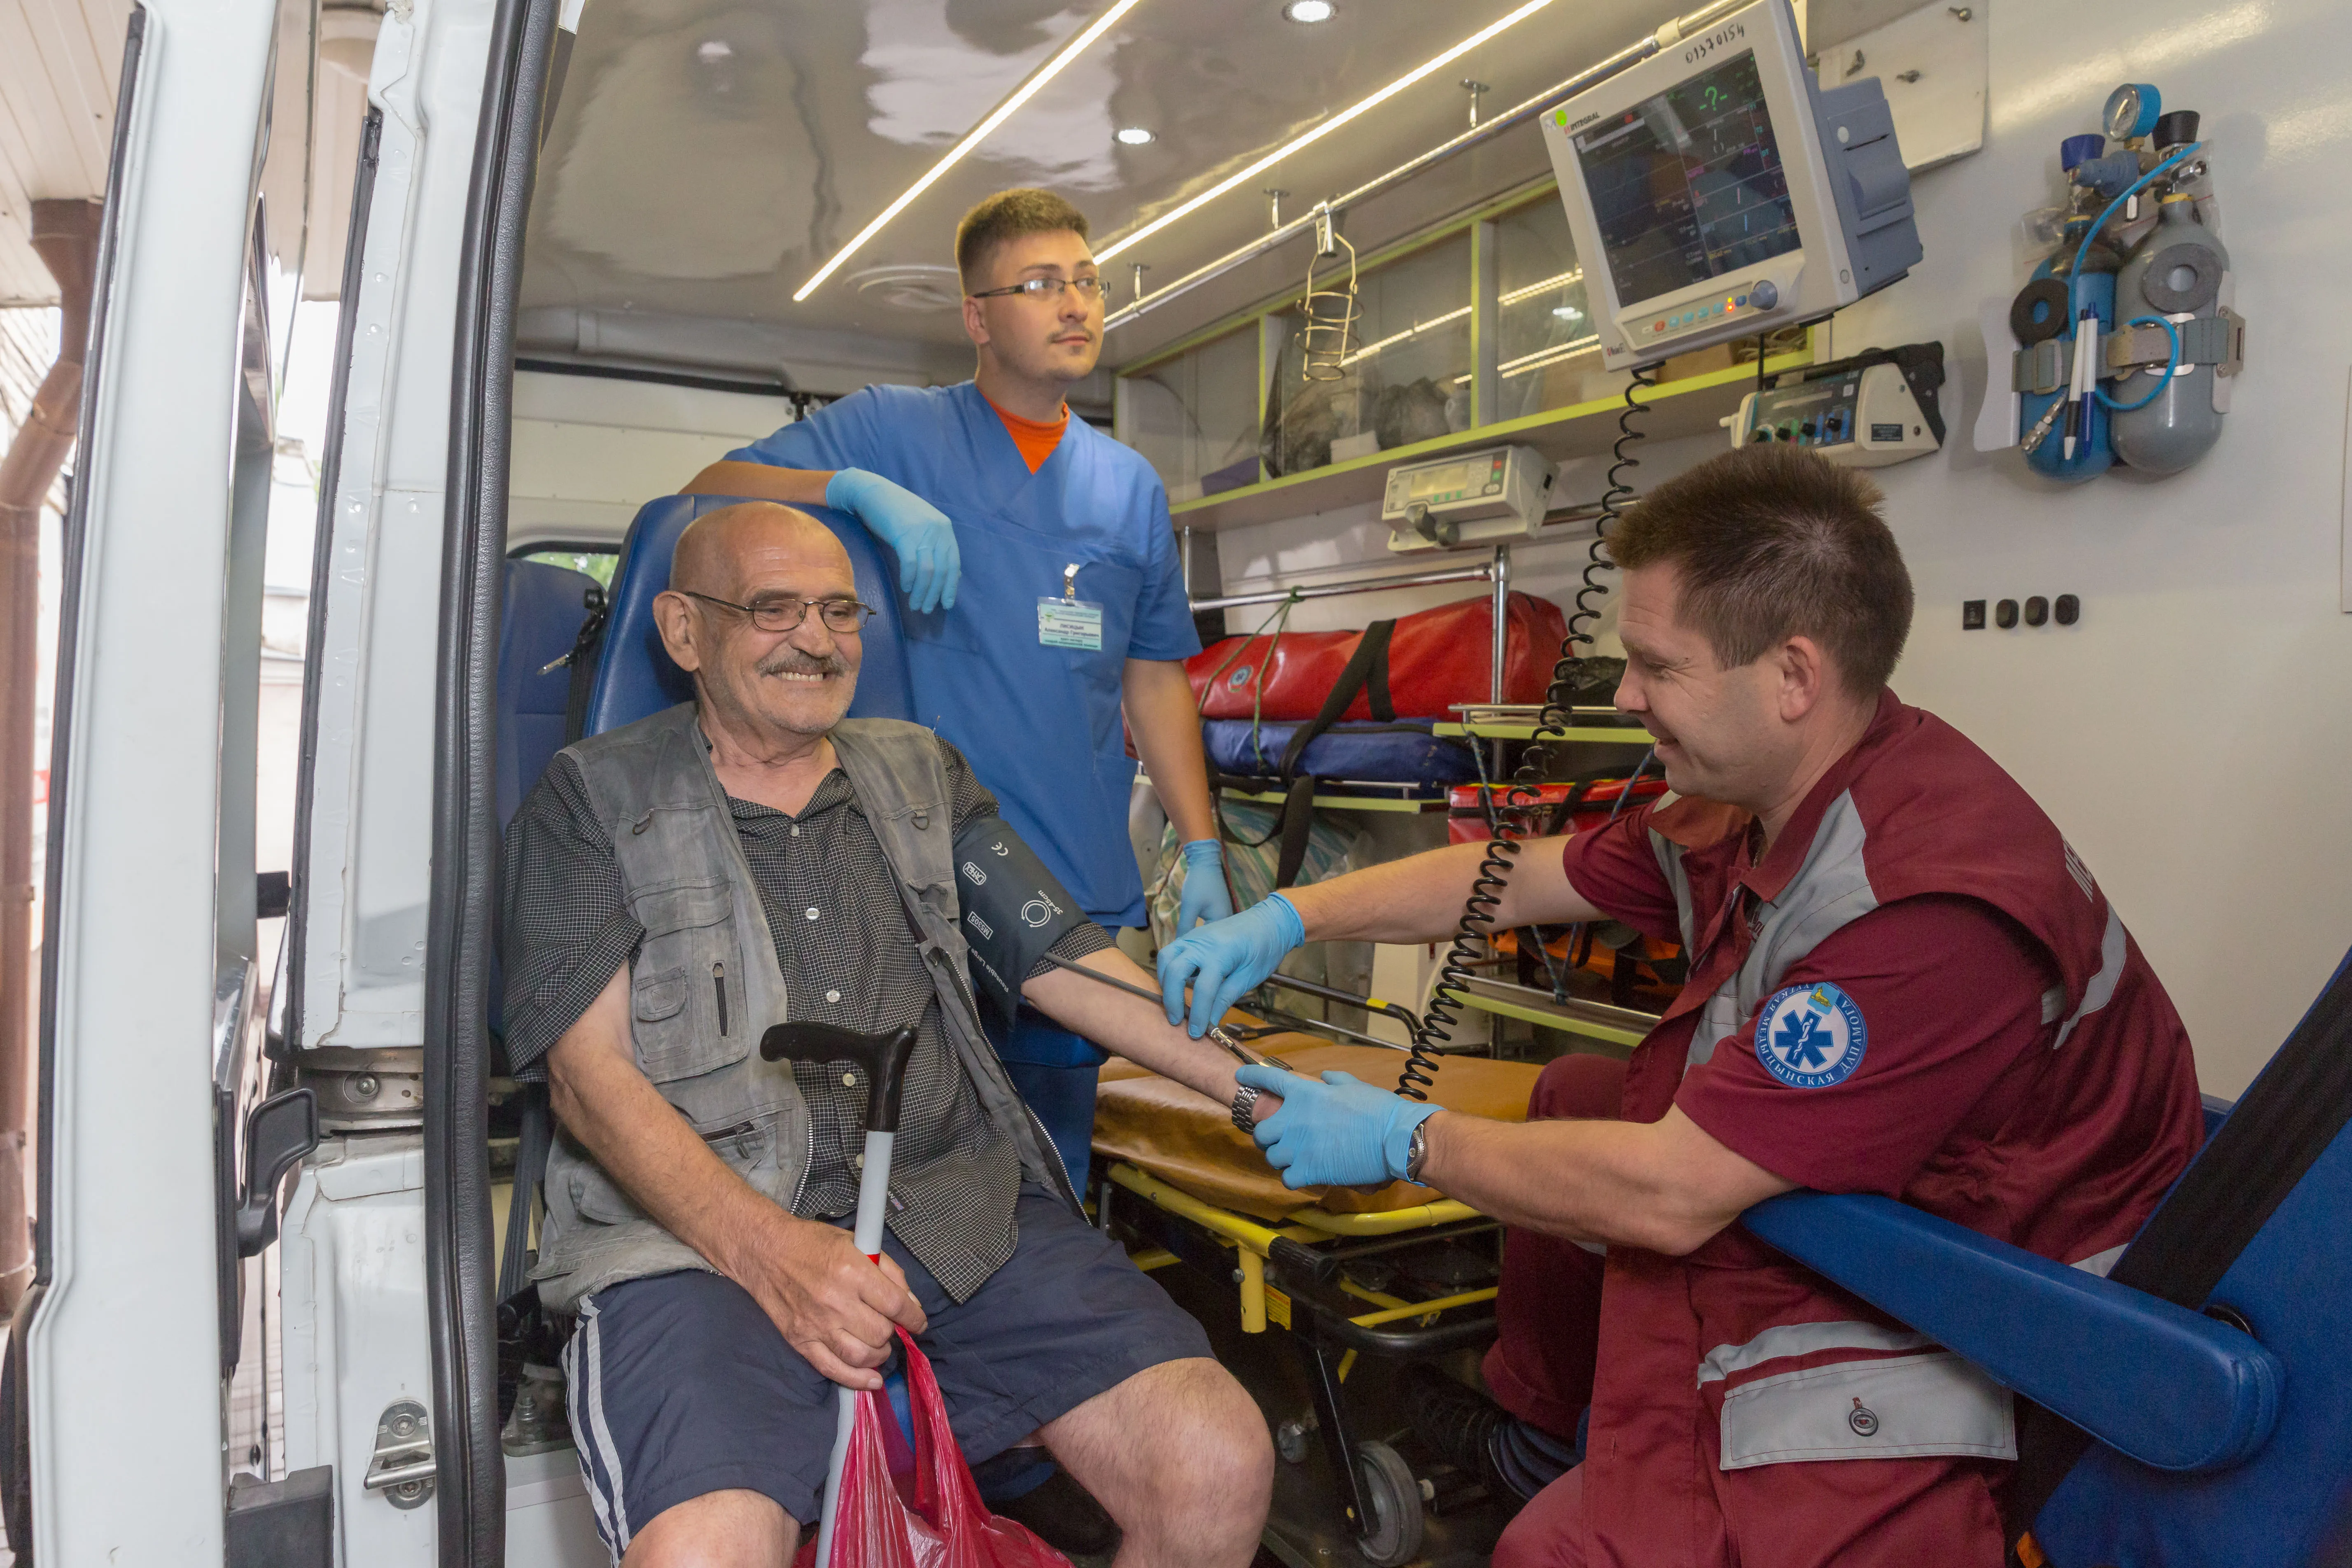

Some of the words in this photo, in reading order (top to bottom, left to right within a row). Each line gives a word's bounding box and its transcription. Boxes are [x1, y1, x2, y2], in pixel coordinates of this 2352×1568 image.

[1570, 111, 1600, 131] INTEGRAL
[1038, 890, 1063, 915] 35-45cm
[971, 915, 990, 936] M5305
[971, 948, 985, 966] Large
[986, 964, 1008, 992] Reusable
[1759, 1016, 1834, 1085] МЕДЫЦЫНСКАЯ
[1840, 1000, 1862, 1073] ДАПАМОГА
